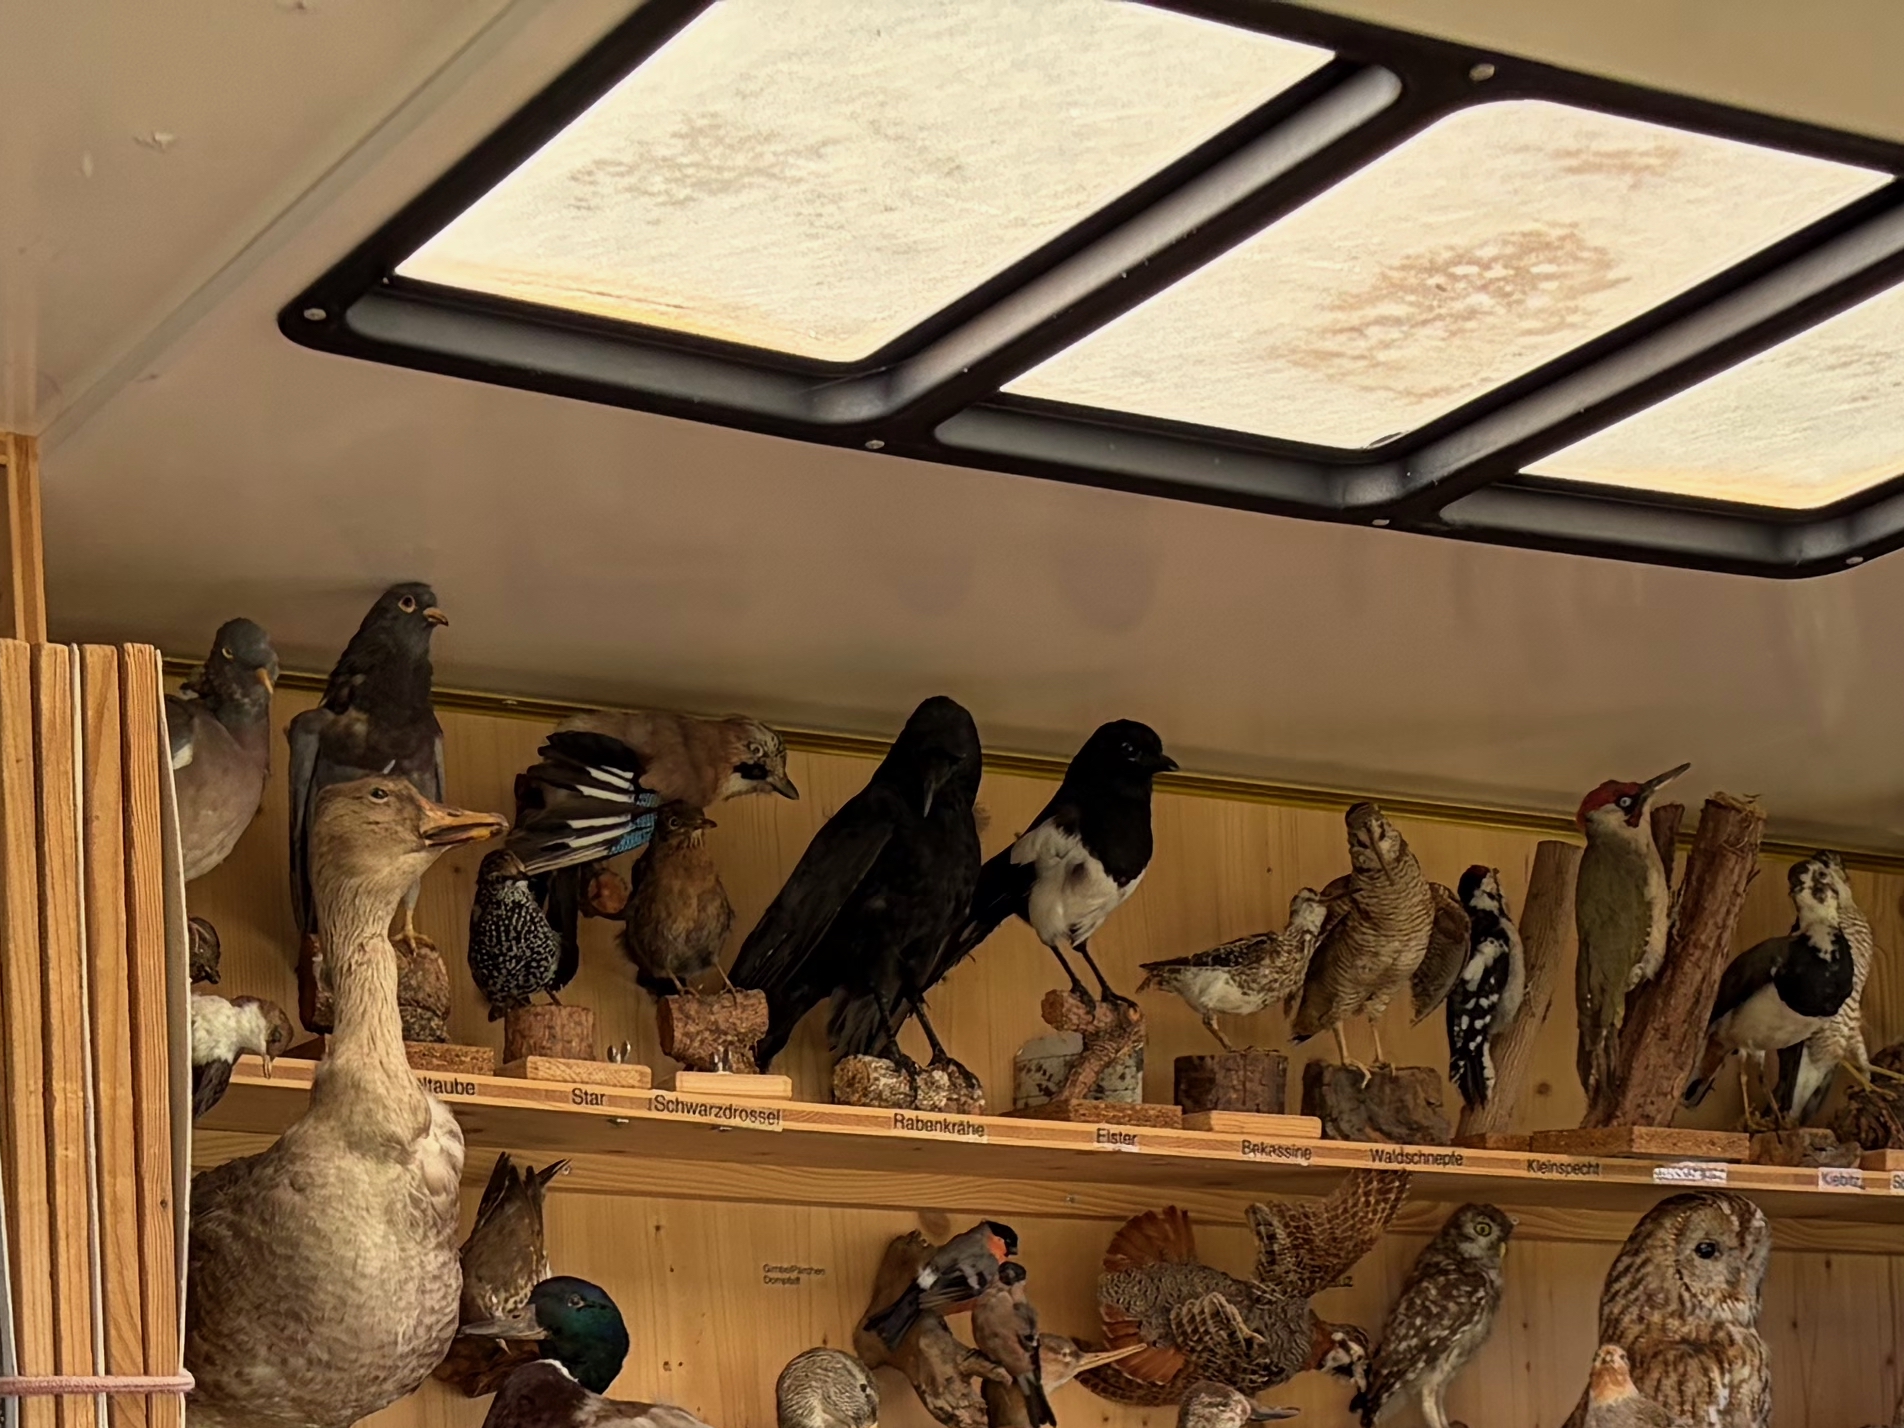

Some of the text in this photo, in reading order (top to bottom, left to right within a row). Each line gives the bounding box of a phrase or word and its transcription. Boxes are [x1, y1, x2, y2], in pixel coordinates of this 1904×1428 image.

[571, 1087, 606, 1107] Star
[653, 1094, 781, 1127] Schwarzdrossel
[893, 1112, 986, 1138] Rabenkrähe
[1096, 1127, 1138, 1147] Elster
[1241, 1139, 1313, 1161] Bekassine
[1369, 1147, 1464, 1168] Waldschnepfe
[1526, 1157, 1601, 1178] Kleinspecht
